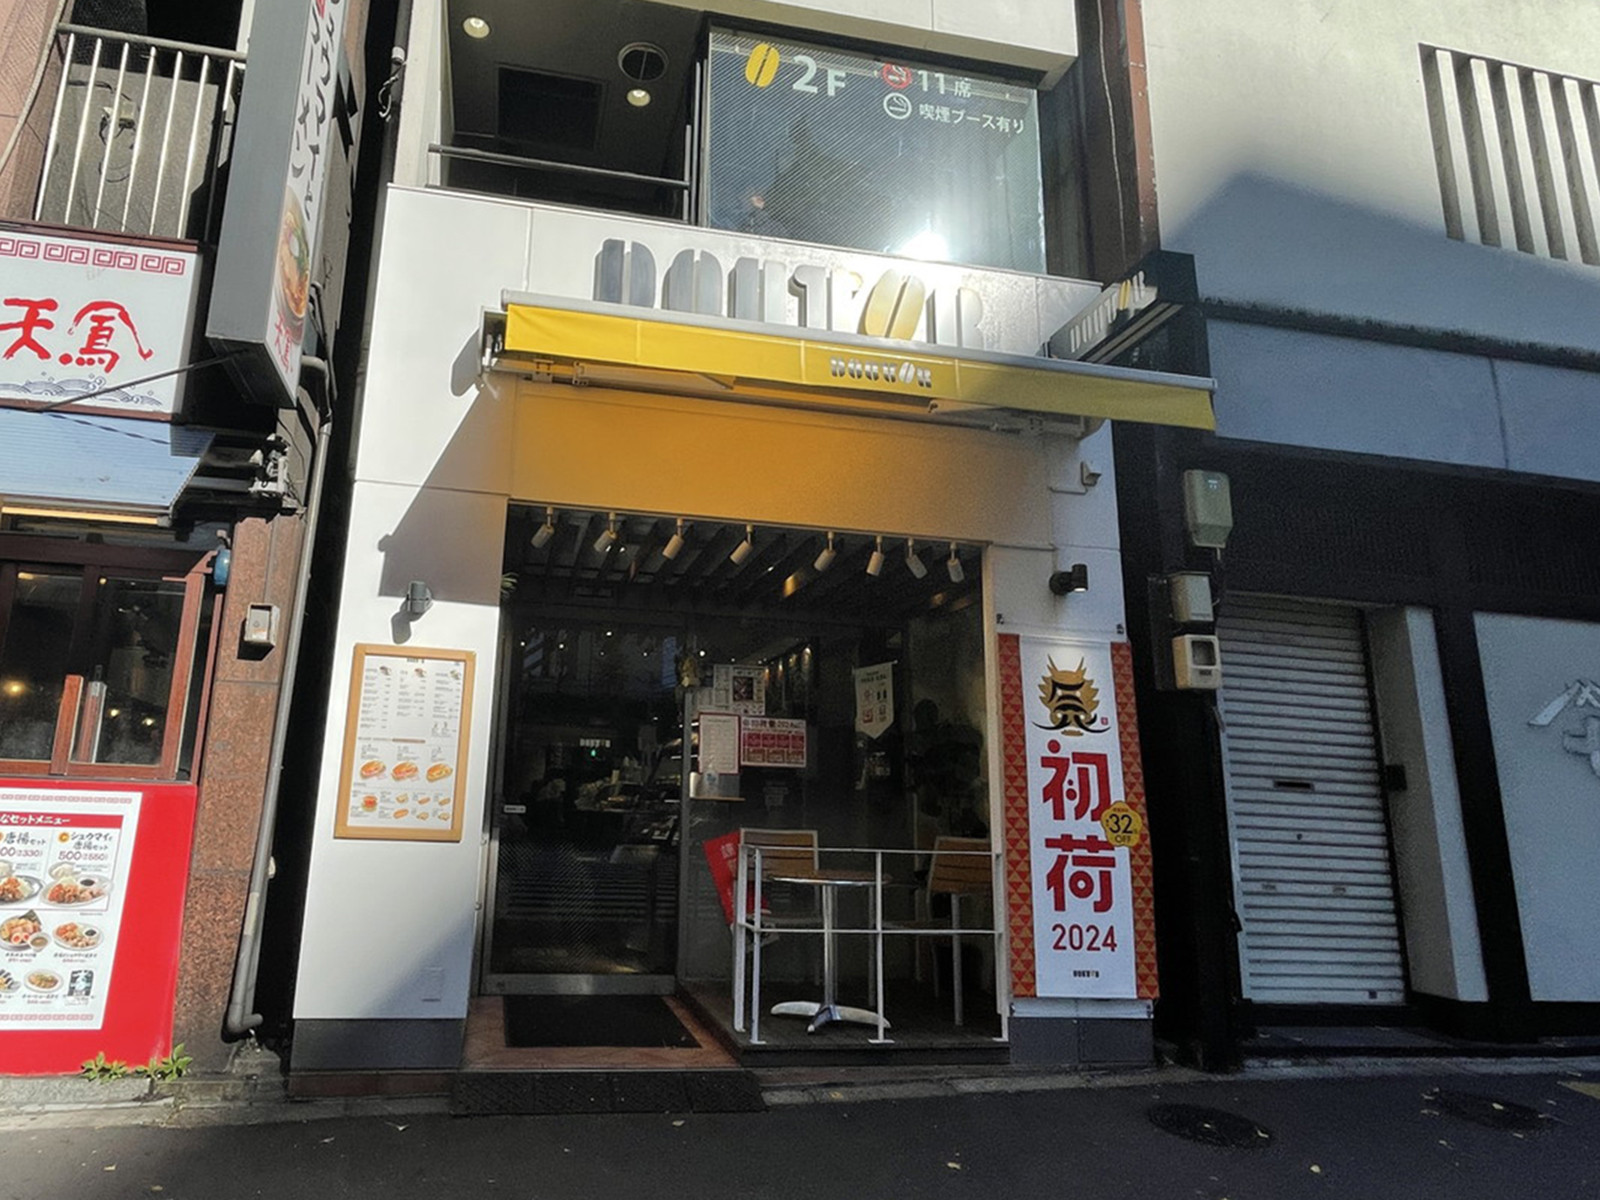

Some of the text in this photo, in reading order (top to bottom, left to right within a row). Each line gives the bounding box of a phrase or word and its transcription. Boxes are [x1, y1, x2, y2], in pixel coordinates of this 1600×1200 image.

[792, 55, 846, 97] 2F
[919, 103, 1024, 134] 喫煙ブース有り
[1051, 923, 1117, 952] 2024
